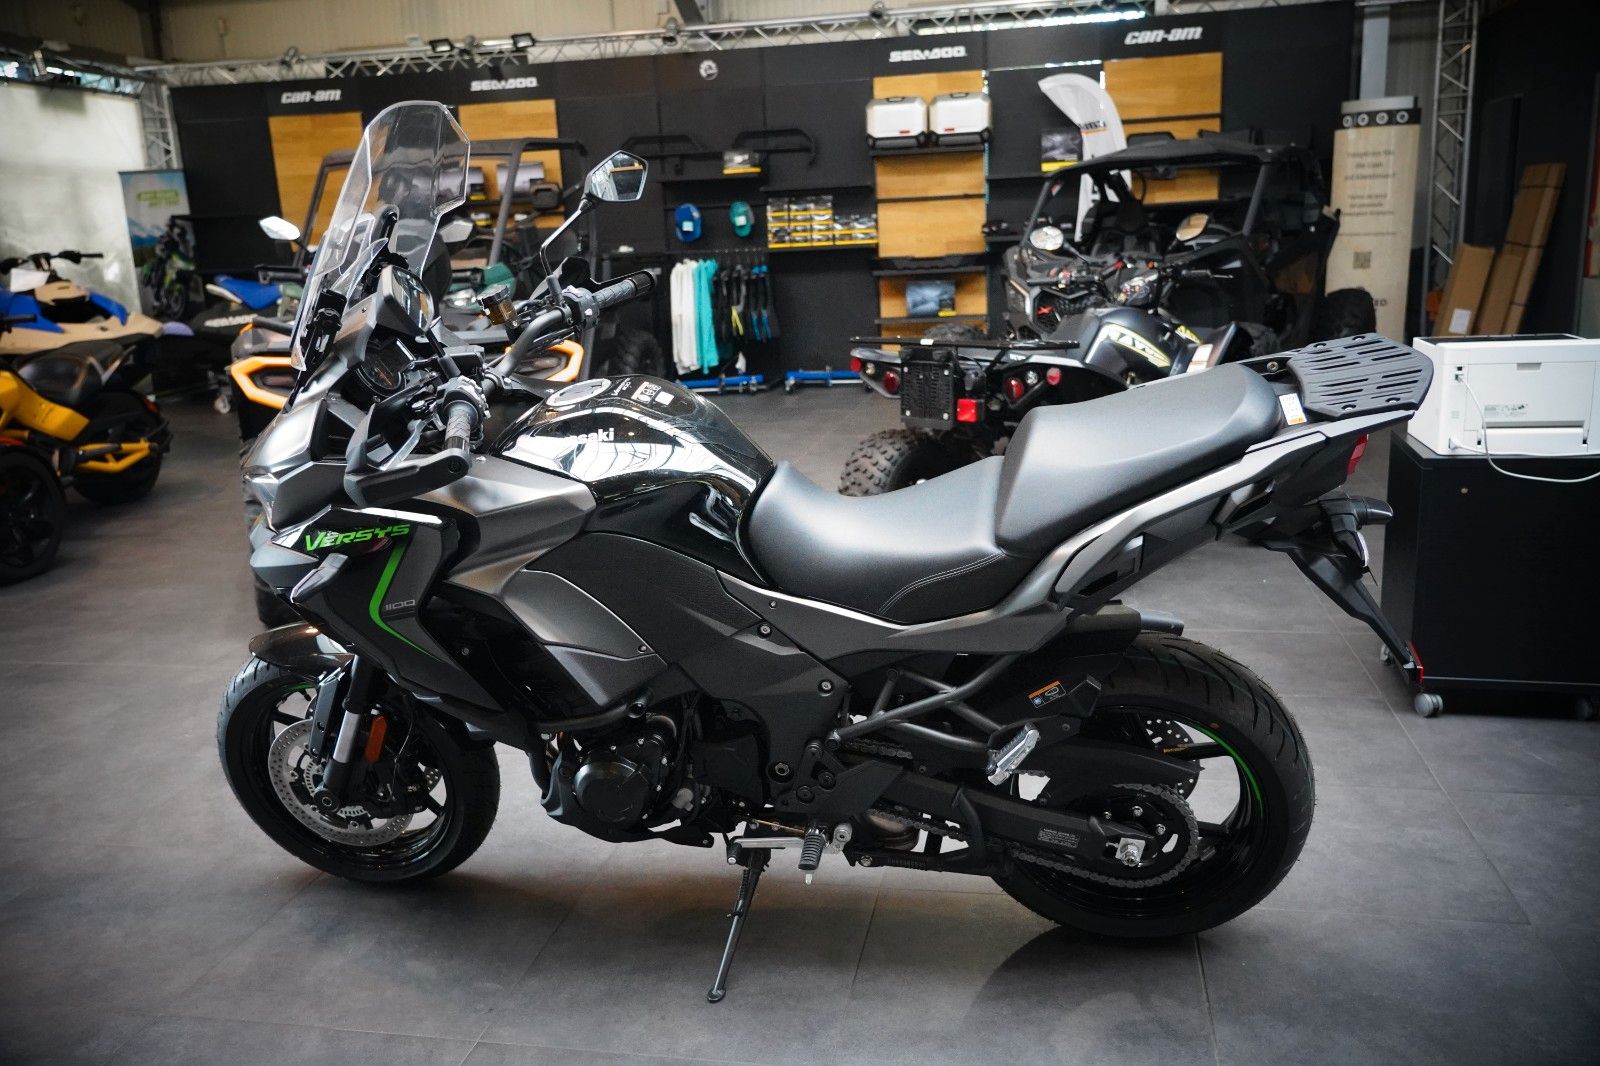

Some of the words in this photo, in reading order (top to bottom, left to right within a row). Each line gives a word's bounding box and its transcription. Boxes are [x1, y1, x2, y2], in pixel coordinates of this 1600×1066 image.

[1124, 26, 1203, 45] can-am
[304, 524, 411, 551] VERSYS
[385, 599, 416, 611] 1100
